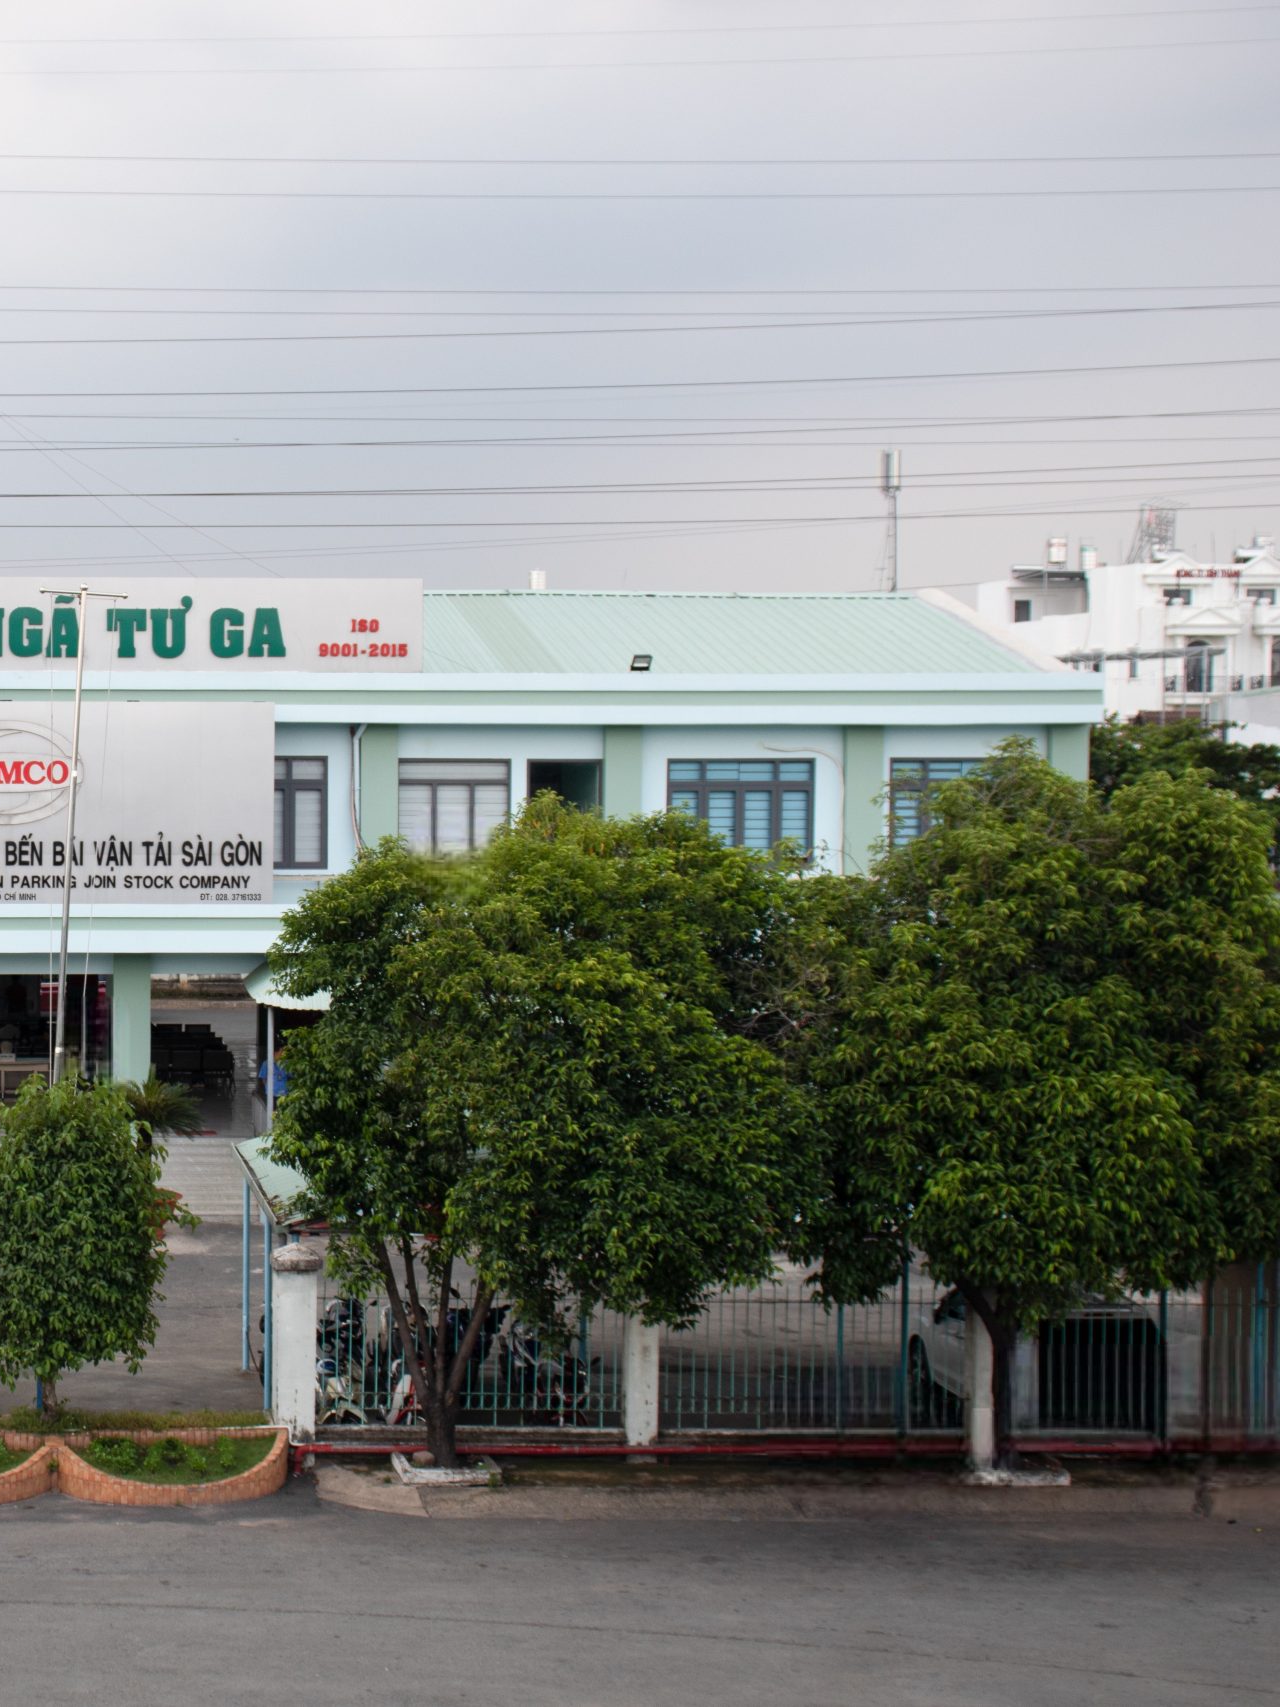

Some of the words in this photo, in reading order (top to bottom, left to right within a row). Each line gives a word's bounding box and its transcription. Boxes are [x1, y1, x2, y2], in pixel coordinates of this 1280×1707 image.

[106, 595, 193, 659] TƯ
[209, 607, 287, 659] GA
[351, 618, 380, 633] ISO
[319, 643, 408, 658] 9001-2015
[4, 833, 43, 867] BẾN
[93, 834, 133, 871] VẬN
[141, 831, 172, 867] TẢI
[181, 834, 213, 867] SÀI
[220, 833, 263, 867] GÒN
[11, 875, 77, 889] PARKING
[83, 875, 116, 889] JOIN
[123, 874, 174, 889] STOCK
[179, 875, 251, 889] COMPANY
[18, 892, 37, 901] MINH
